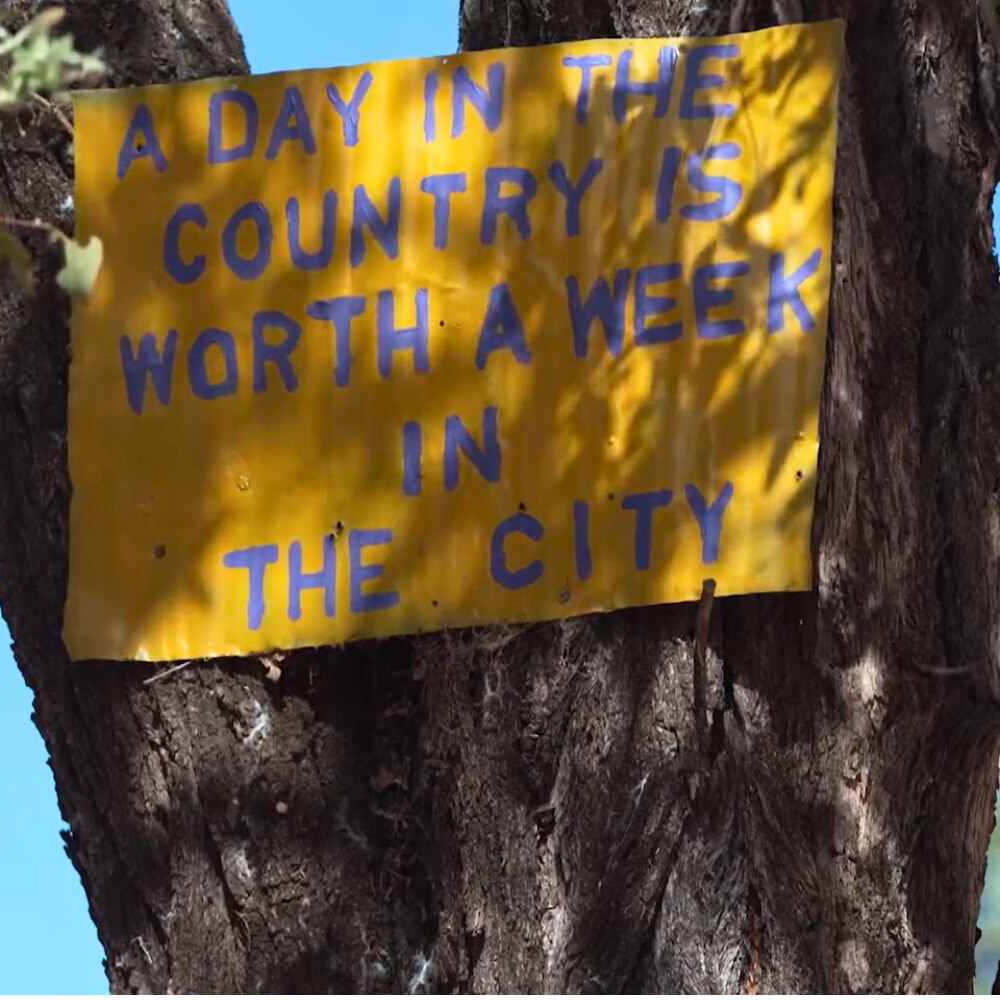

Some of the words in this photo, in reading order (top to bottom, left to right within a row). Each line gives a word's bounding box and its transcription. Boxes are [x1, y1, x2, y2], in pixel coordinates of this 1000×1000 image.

[117, 105, 168, 178] A
[206, 70, 373, 164] DAY
[423, 61, 505, 143] IN
[562, 44, 739, 124] THE
[163, 157, 603, 284] COUNTRY
[655, 142, 743, 223] IS
[119, 287, 431, 413] WORTH
[475, 282, 533, 370] A
[565, 248, 823, 359] WEEK
[402, 405, 501, 496] IN
[223, 528, 399, 630] THE
[490, 481, 734, 590] CITY
